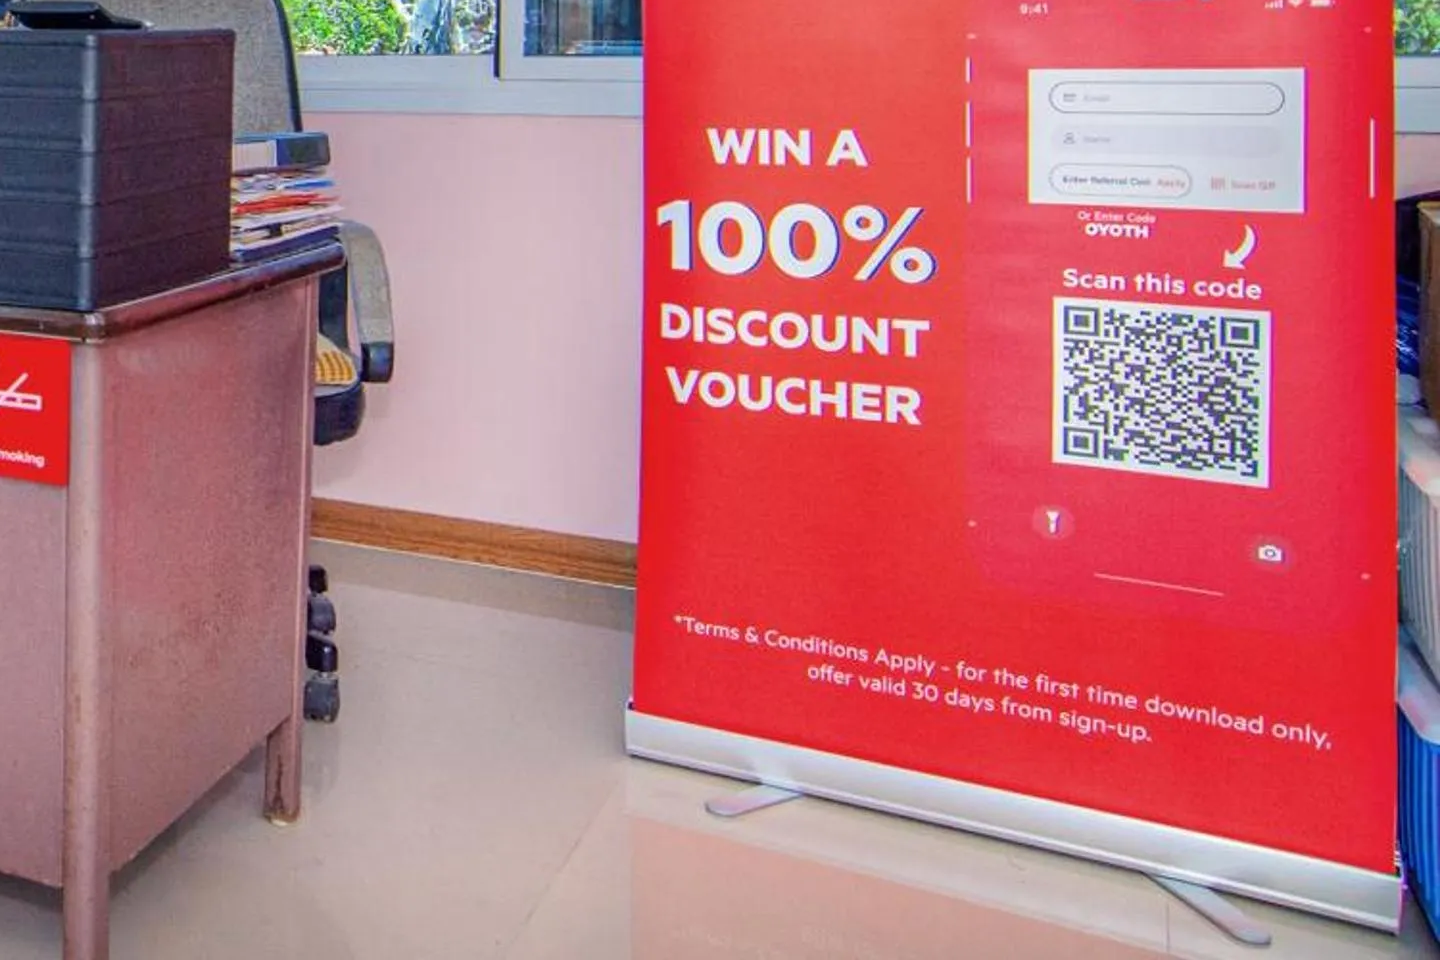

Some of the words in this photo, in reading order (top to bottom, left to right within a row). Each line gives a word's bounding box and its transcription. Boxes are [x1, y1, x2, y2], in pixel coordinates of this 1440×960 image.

[1019, 2, 1048, 16] 9:41
[706, 128, 811, 166] WIN
[825, 129, 869, 167] A
[1077, 210, 1091, 221] Or
[1094, 211, 1124, 223] Enter
[1127, 213, 1157, 225] Code
[1084, 222, 1151, 239] OYOTH
[656, 200, 937, 283] 100%
[1062, 268, 1126, 290] Scan
[1133, 271, 1186, 295] this
[1193, 277, 1263, 300] code
[661, 302, 931, 358] DISCOUNT
[665, 366, 922, 426] VOUCHER
[744, 626, 760, 645] &
[764, 629, 869, 662] Conditions
[874, 648, 935, 677] Apply
[956, 660, 986, 682] for
[993, 667, 1028, 689] the
[1035, 675, 1080, 699] first
[1086, 683, 1138, 710] time
[1145, 694, 1264, 735] download
[807, 664, 853, 687] offer
[858, 677, 906, 697] valid
[911, 681, 939, 702] 30
[944, 687, 995, 713] days
[1001, 696, 1052, 723] from
[1059, 709, 1152, 743] sign-up.
